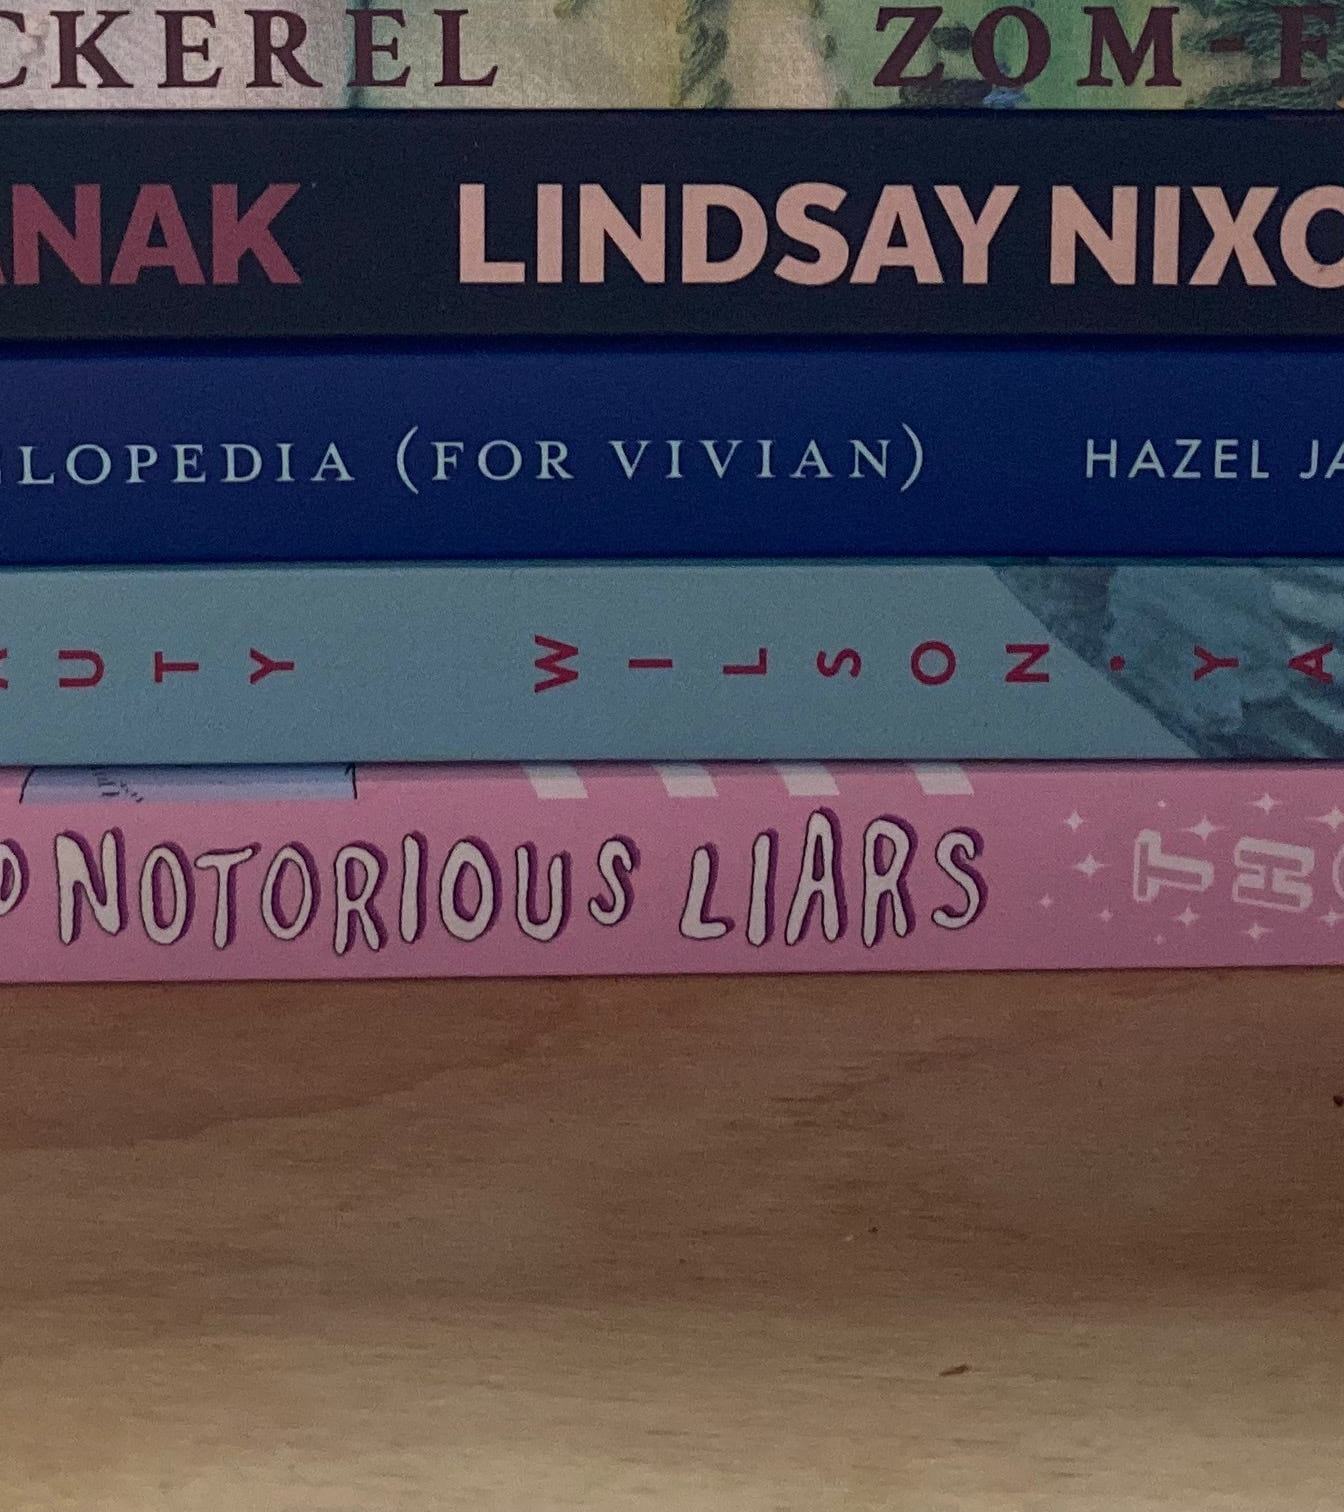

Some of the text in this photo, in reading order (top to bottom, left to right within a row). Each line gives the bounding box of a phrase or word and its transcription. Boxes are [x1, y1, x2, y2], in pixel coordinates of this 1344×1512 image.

[459, 181, 1020, 285] LINDSAY
[395, 425, 575, 495] (FOR
[608, 423, 926, 492] VIVIAN)
[1085, 438, 1270, 479] HAZEL
[56, 826, 642, 957] NOTORIOUS
[678, 806, 990, 950] LIARS
